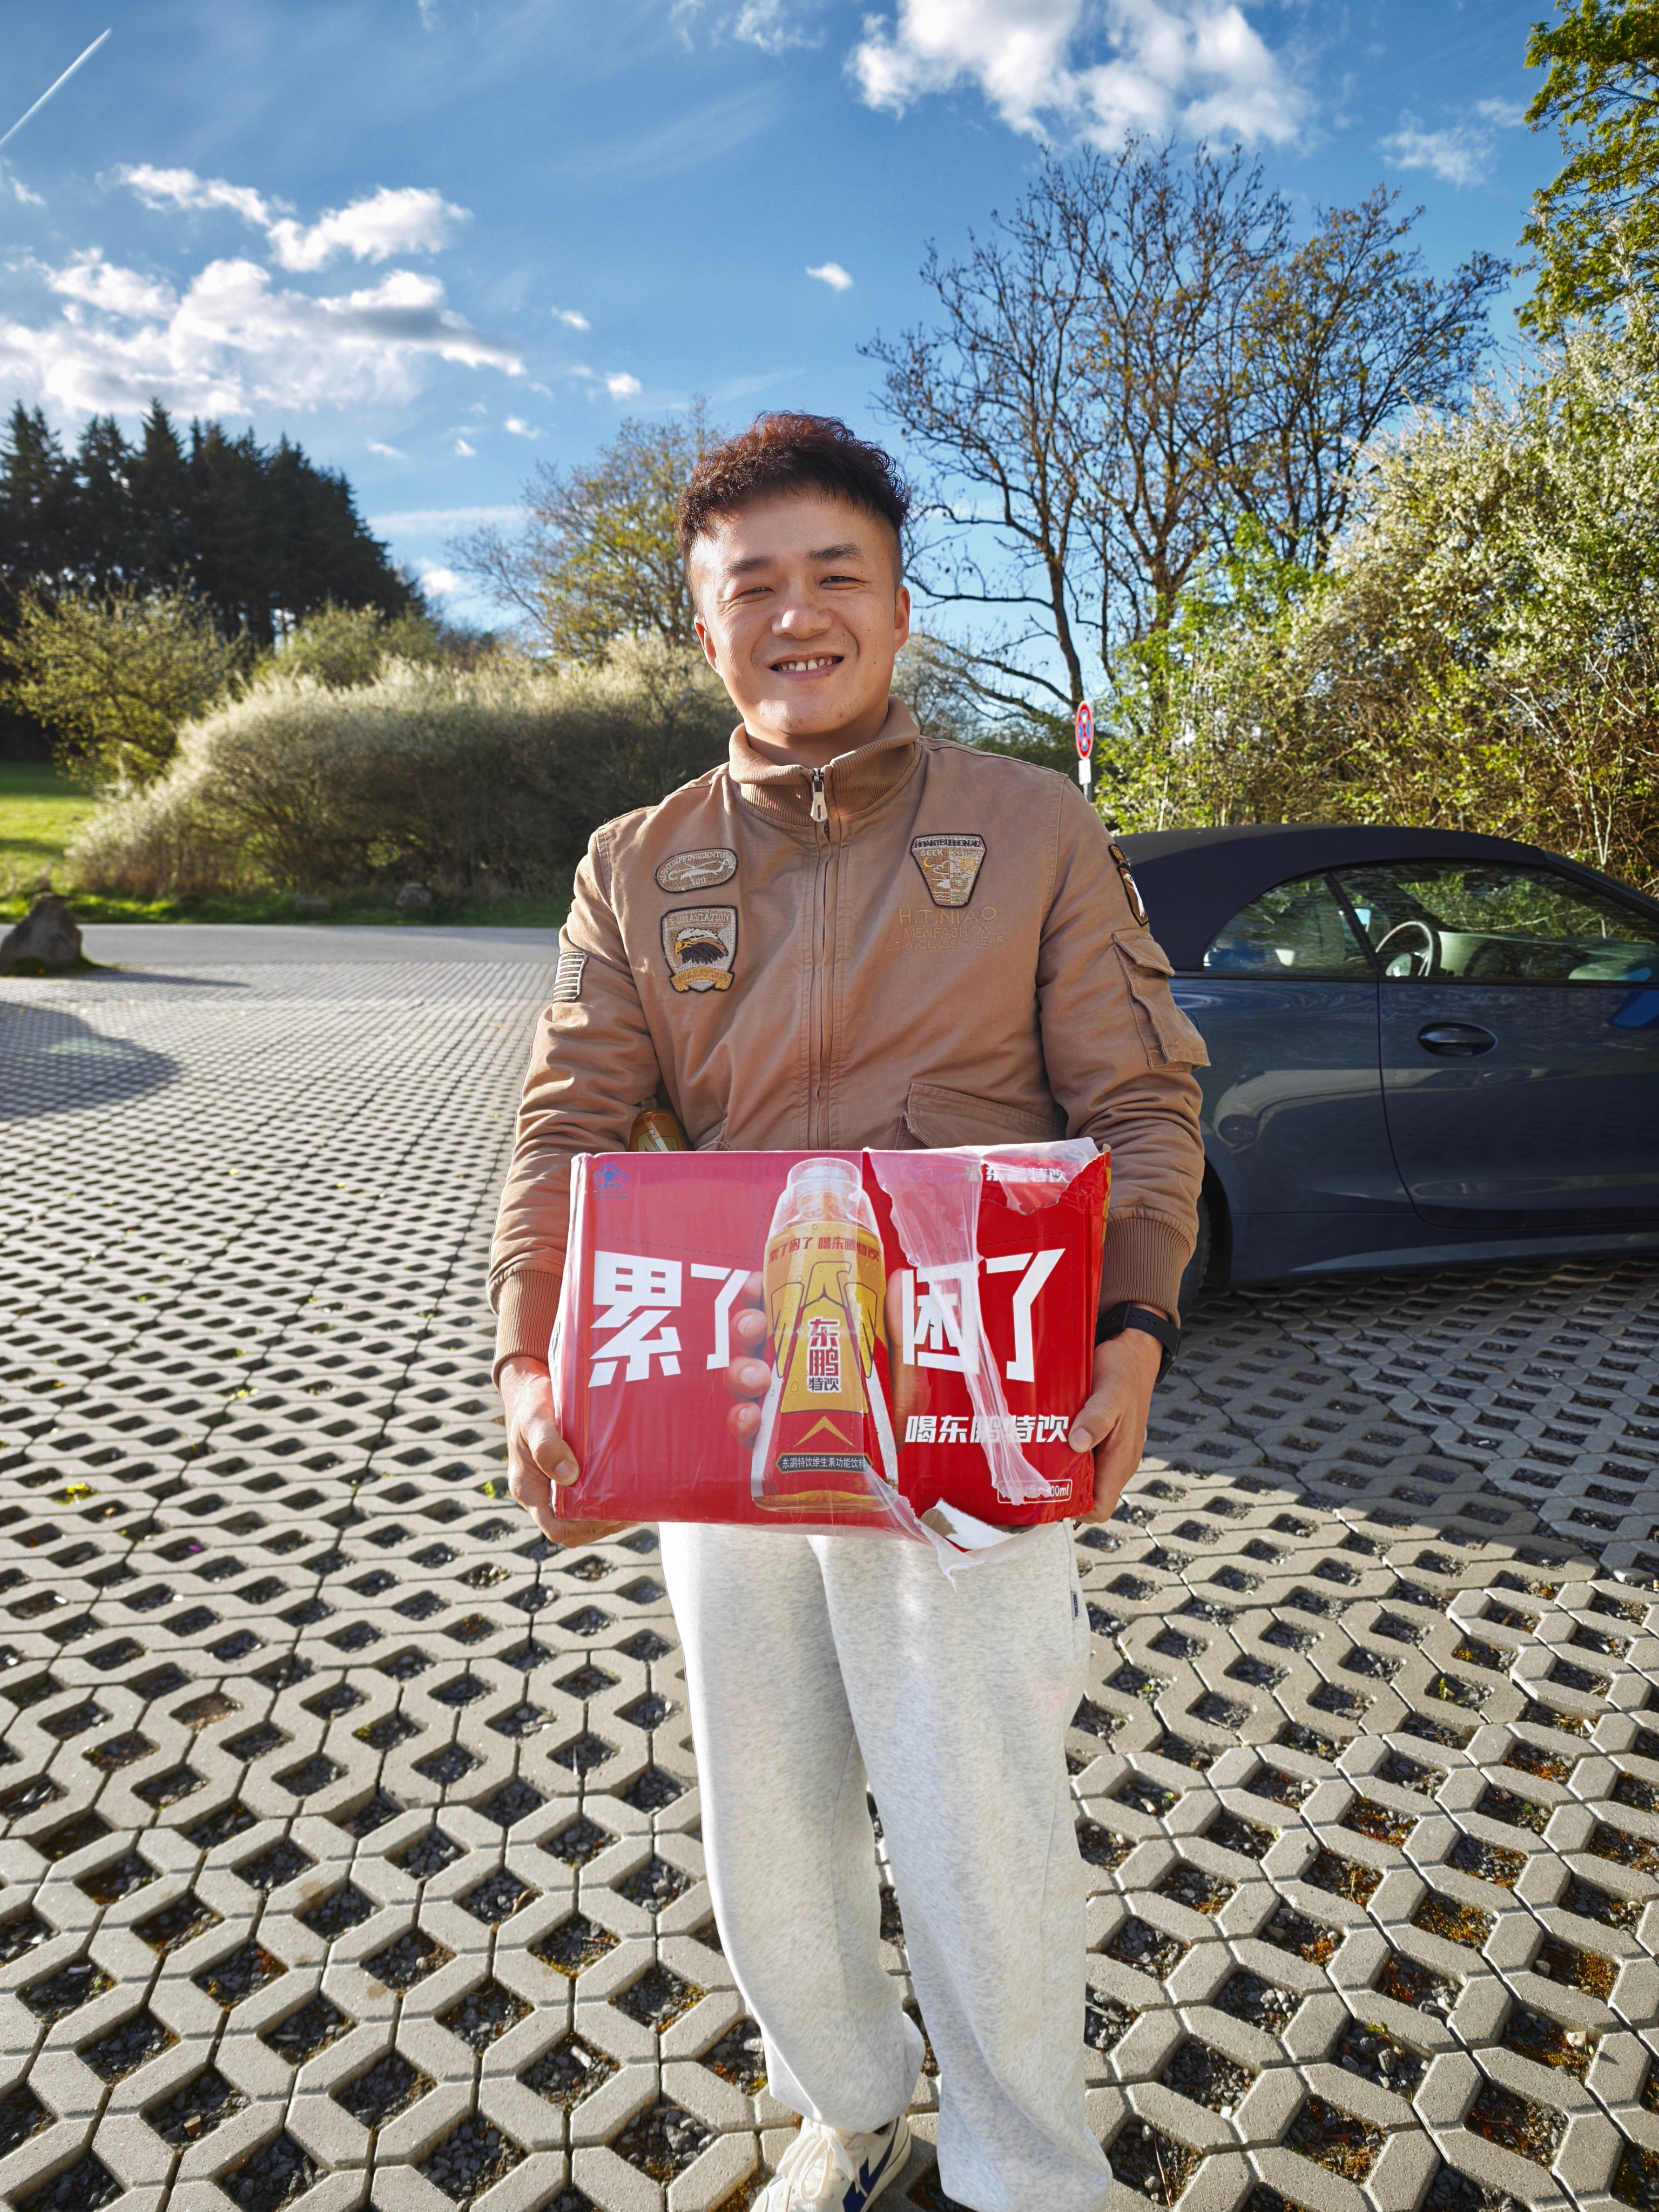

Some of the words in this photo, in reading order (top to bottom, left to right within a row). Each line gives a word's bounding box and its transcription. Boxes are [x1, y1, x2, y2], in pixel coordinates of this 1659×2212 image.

[692, 877, 706, 886] 100
[768, 1237, 814, 1264] 累了困了
[818, 1236, 880, 1263] 喝东鹏特饮
[588, 1250, 751, 1388] 累了
[901, 1248, 1066, 1382] 困了
[809, 1318, 839, 1377] 东鹏
[809, 1377, 840, 1391] 特饮
[782, 1457, 866, 1469] 东鹏特饮维生素功能饮料
